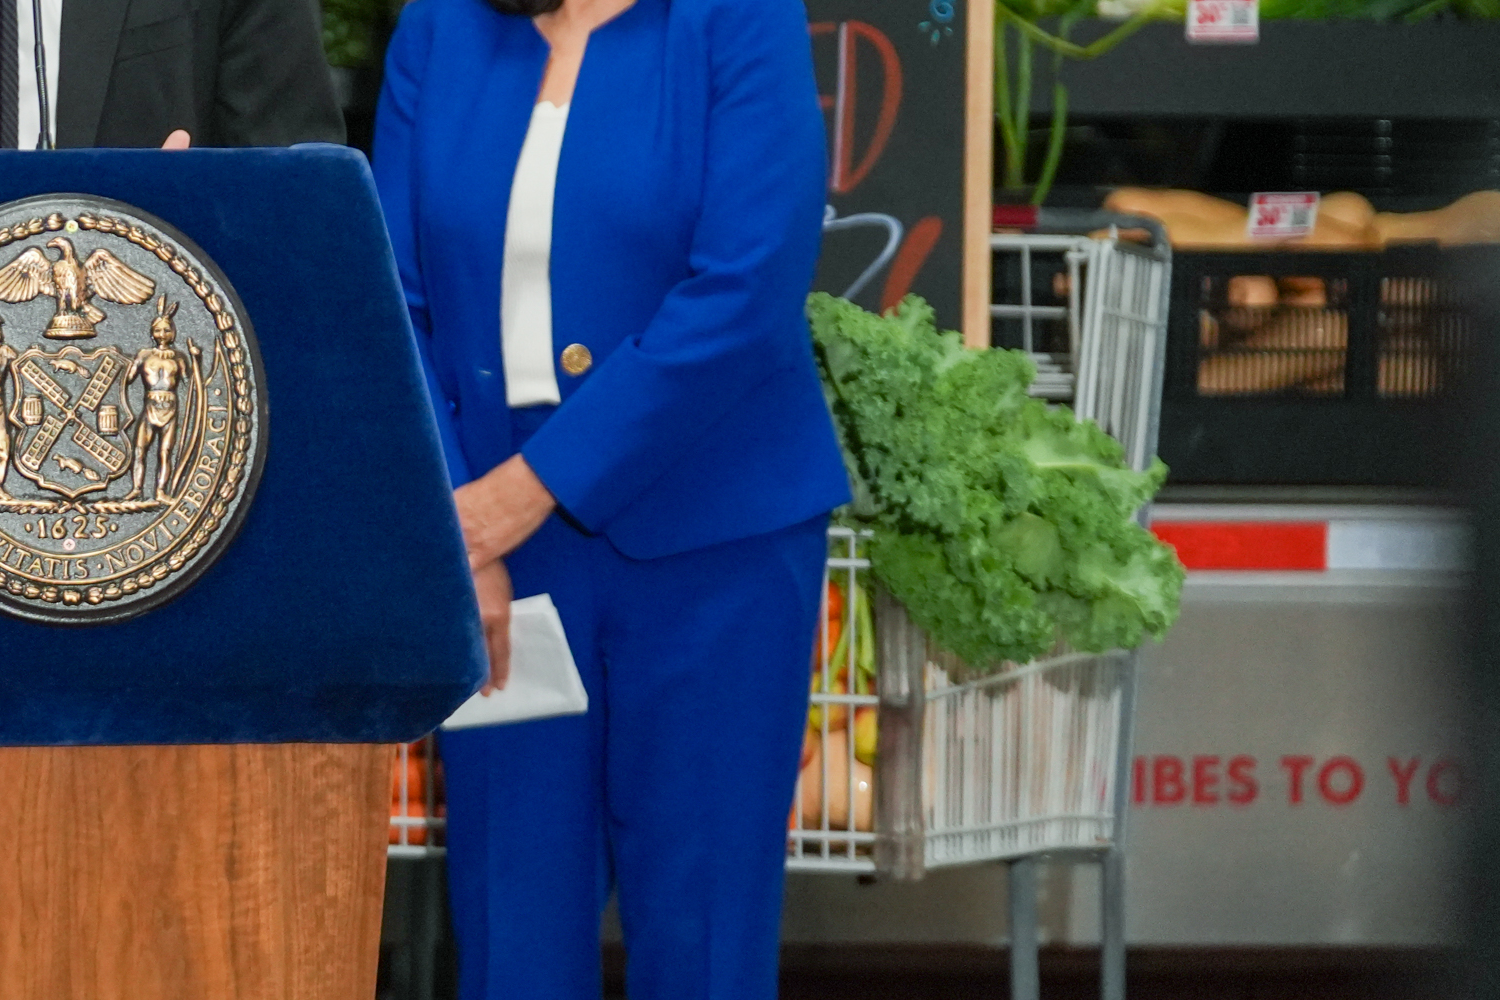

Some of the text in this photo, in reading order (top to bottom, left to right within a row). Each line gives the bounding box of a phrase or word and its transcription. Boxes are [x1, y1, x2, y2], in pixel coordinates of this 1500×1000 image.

[105, 523, 175, 573] NOVI
[174, 405, 228, 523] EBORACI
[37, 515, 110, 539] 1625
[1131, 754, 1260, 807] IBES
[1280, 754, 1365, 806] TO
